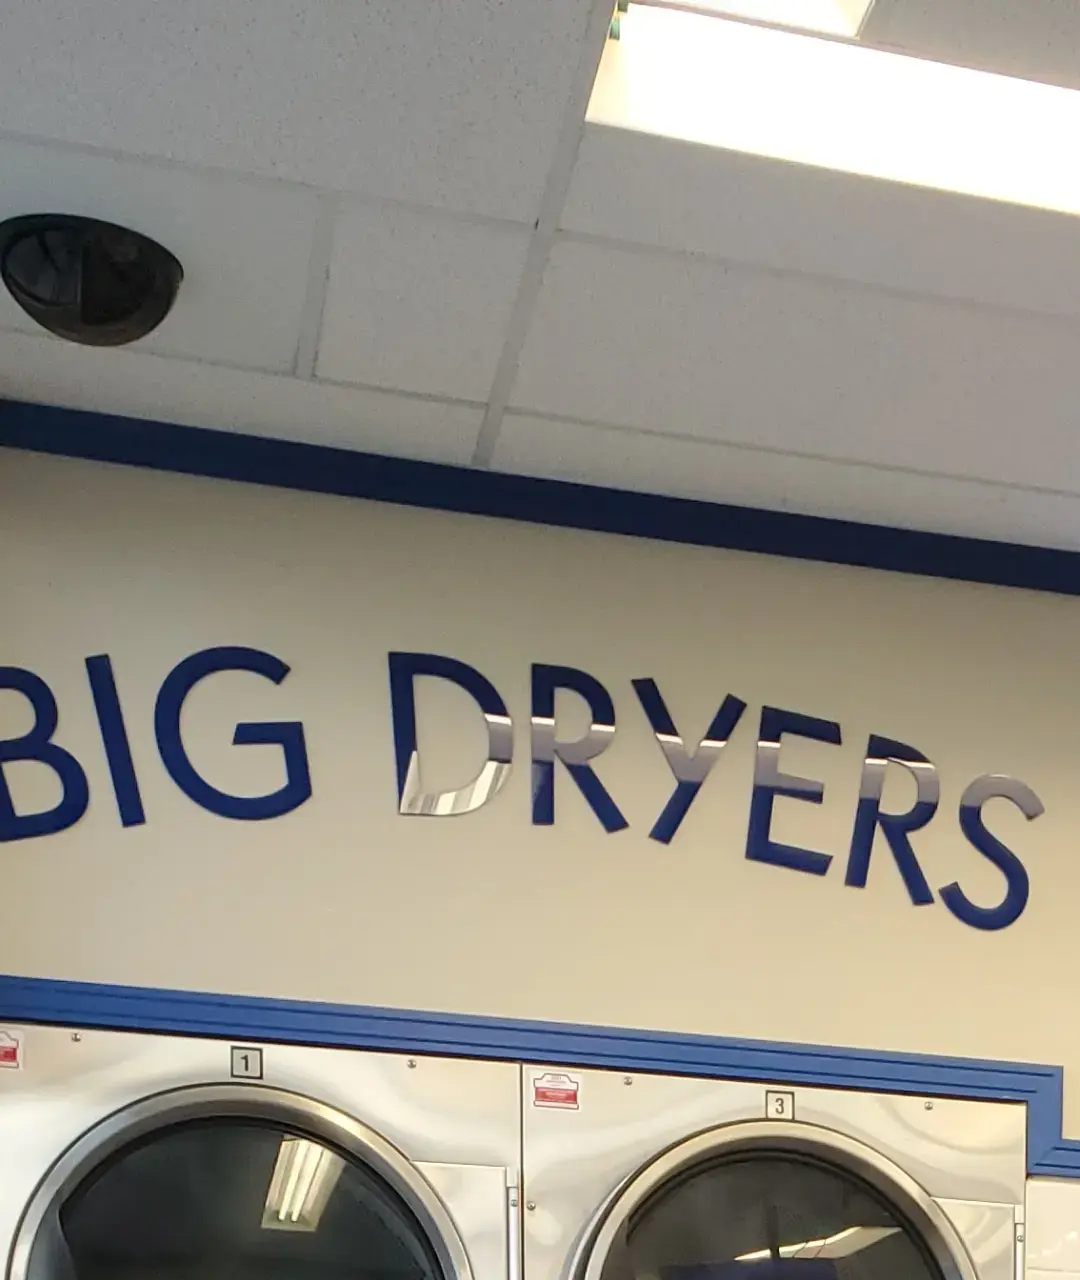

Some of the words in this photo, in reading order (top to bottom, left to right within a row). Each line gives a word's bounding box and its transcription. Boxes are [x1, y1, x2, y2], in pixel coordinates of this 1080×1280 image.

[0, 645, 312, 842] BIG
[388, 651, 1045, 930] DRYERS
[240, 1054, 249, 1072] 1
[775, 1097, 785, 1115] 3
